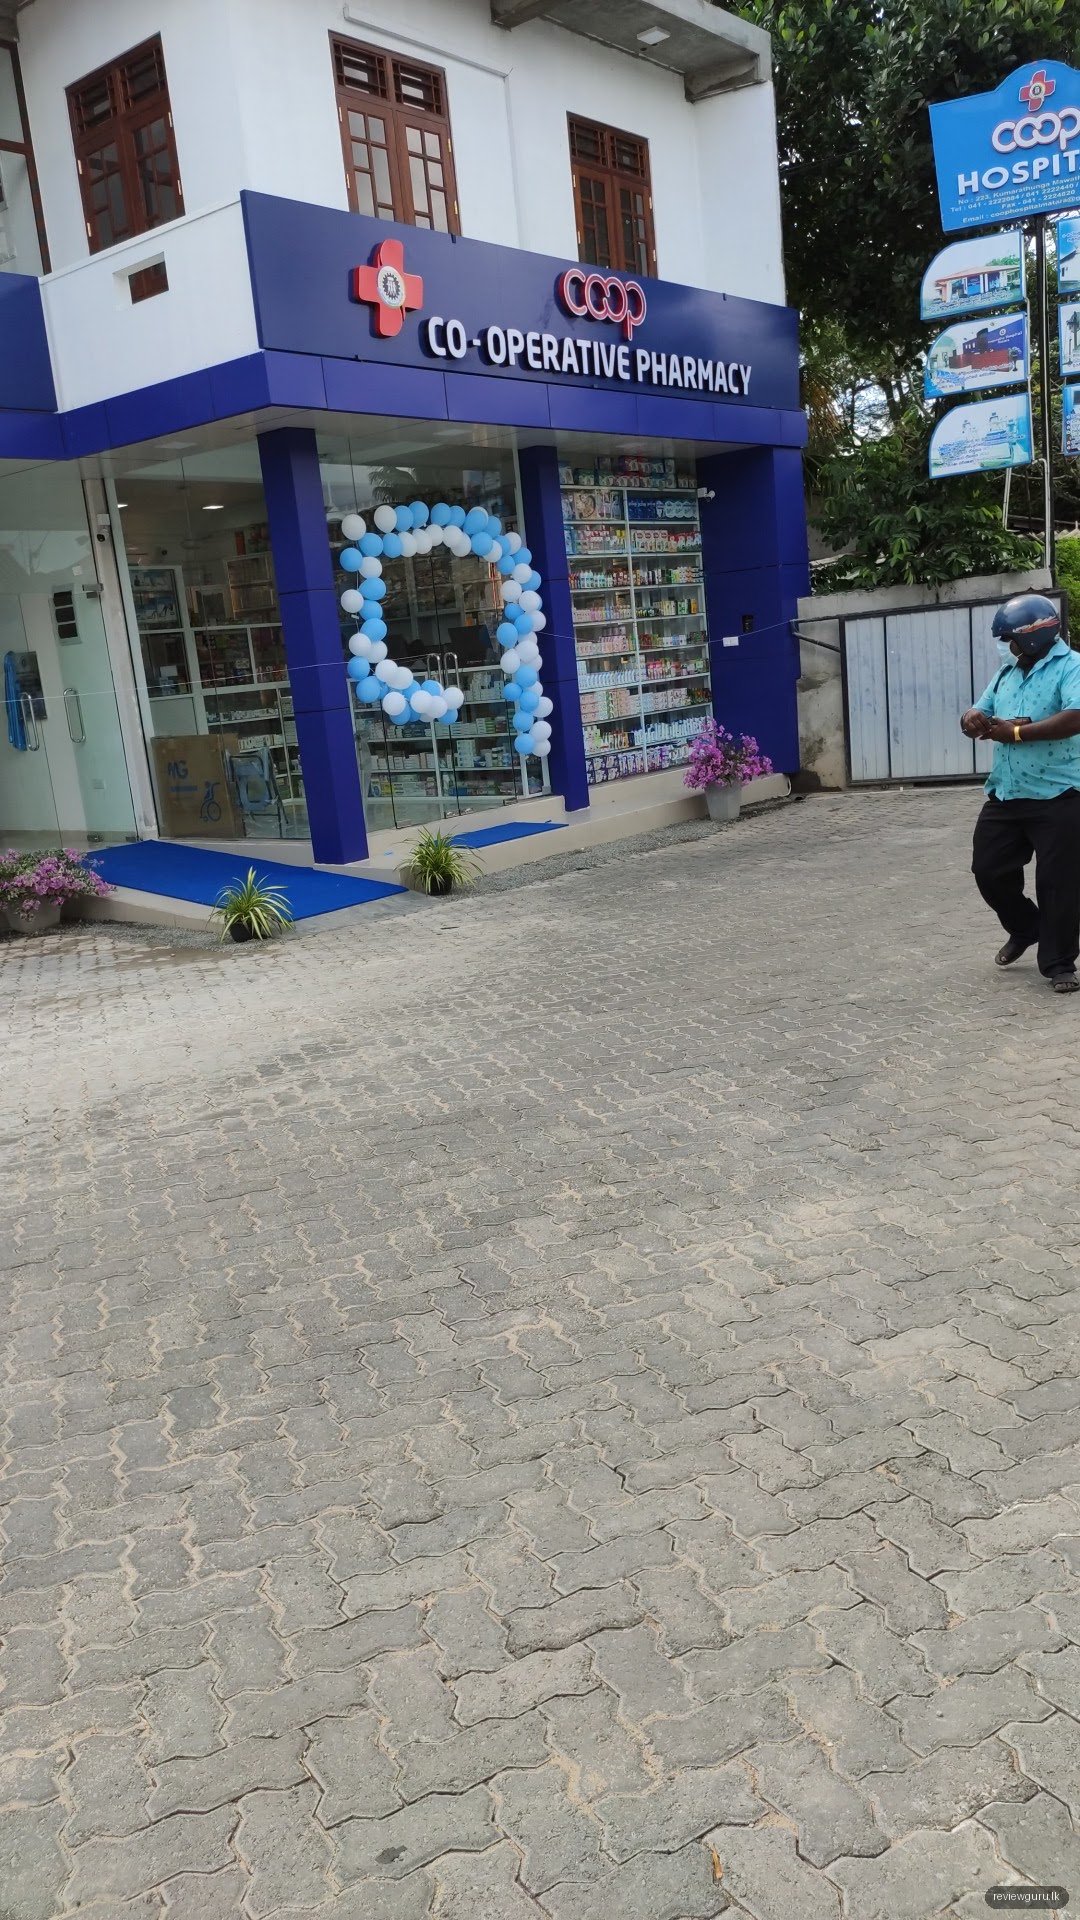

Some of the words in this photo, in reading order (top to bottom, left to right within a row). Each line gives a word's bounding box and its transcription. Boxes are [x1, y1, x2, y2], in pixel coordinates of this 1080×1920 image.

[957, 149, 1080, 196] HOSPIT
[993, 182, 1050, 198] Kumarathunga
[1025, 190, 1039, 198] 041
[962, 214, 984, 223] Email
[636, 348, 752, 396] PHARMACY
